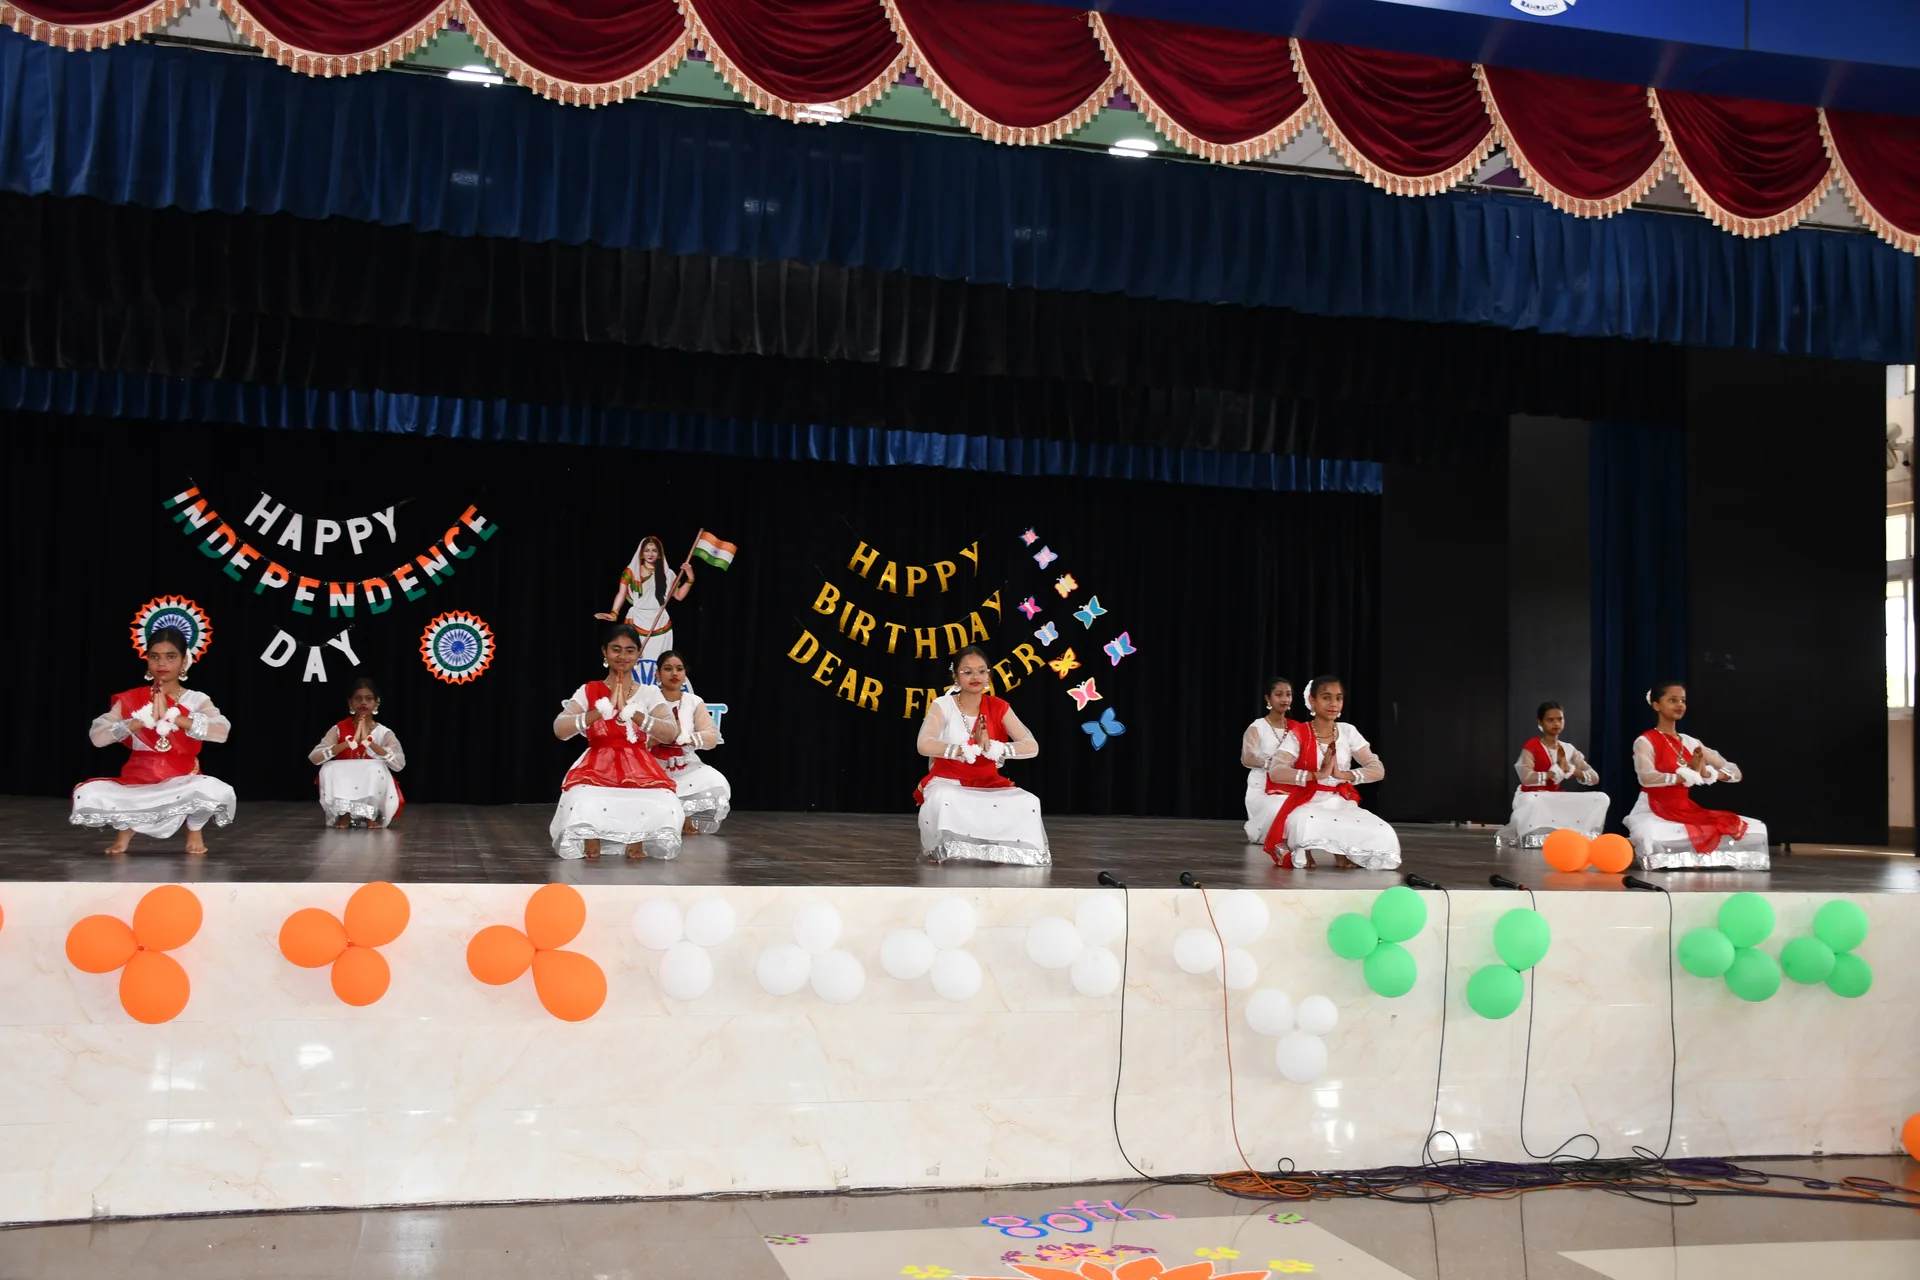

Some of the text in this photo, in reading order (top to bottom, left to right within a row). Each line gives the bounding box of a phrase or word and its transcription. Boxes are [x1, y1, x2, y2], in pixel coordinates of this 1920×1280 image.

[162, 486, 499, 618] INDEPENDENCE
[244, 493, 397, 555] HAPPY
[847, 541, 979, 597] HAPPY
[812, 581, 1002, 659] BIRTHDAY
[260, 629, 361, 682] DAY
[787, 630, 884, 712] DEAR
[981, 1199, 1176, 1239] 80th
